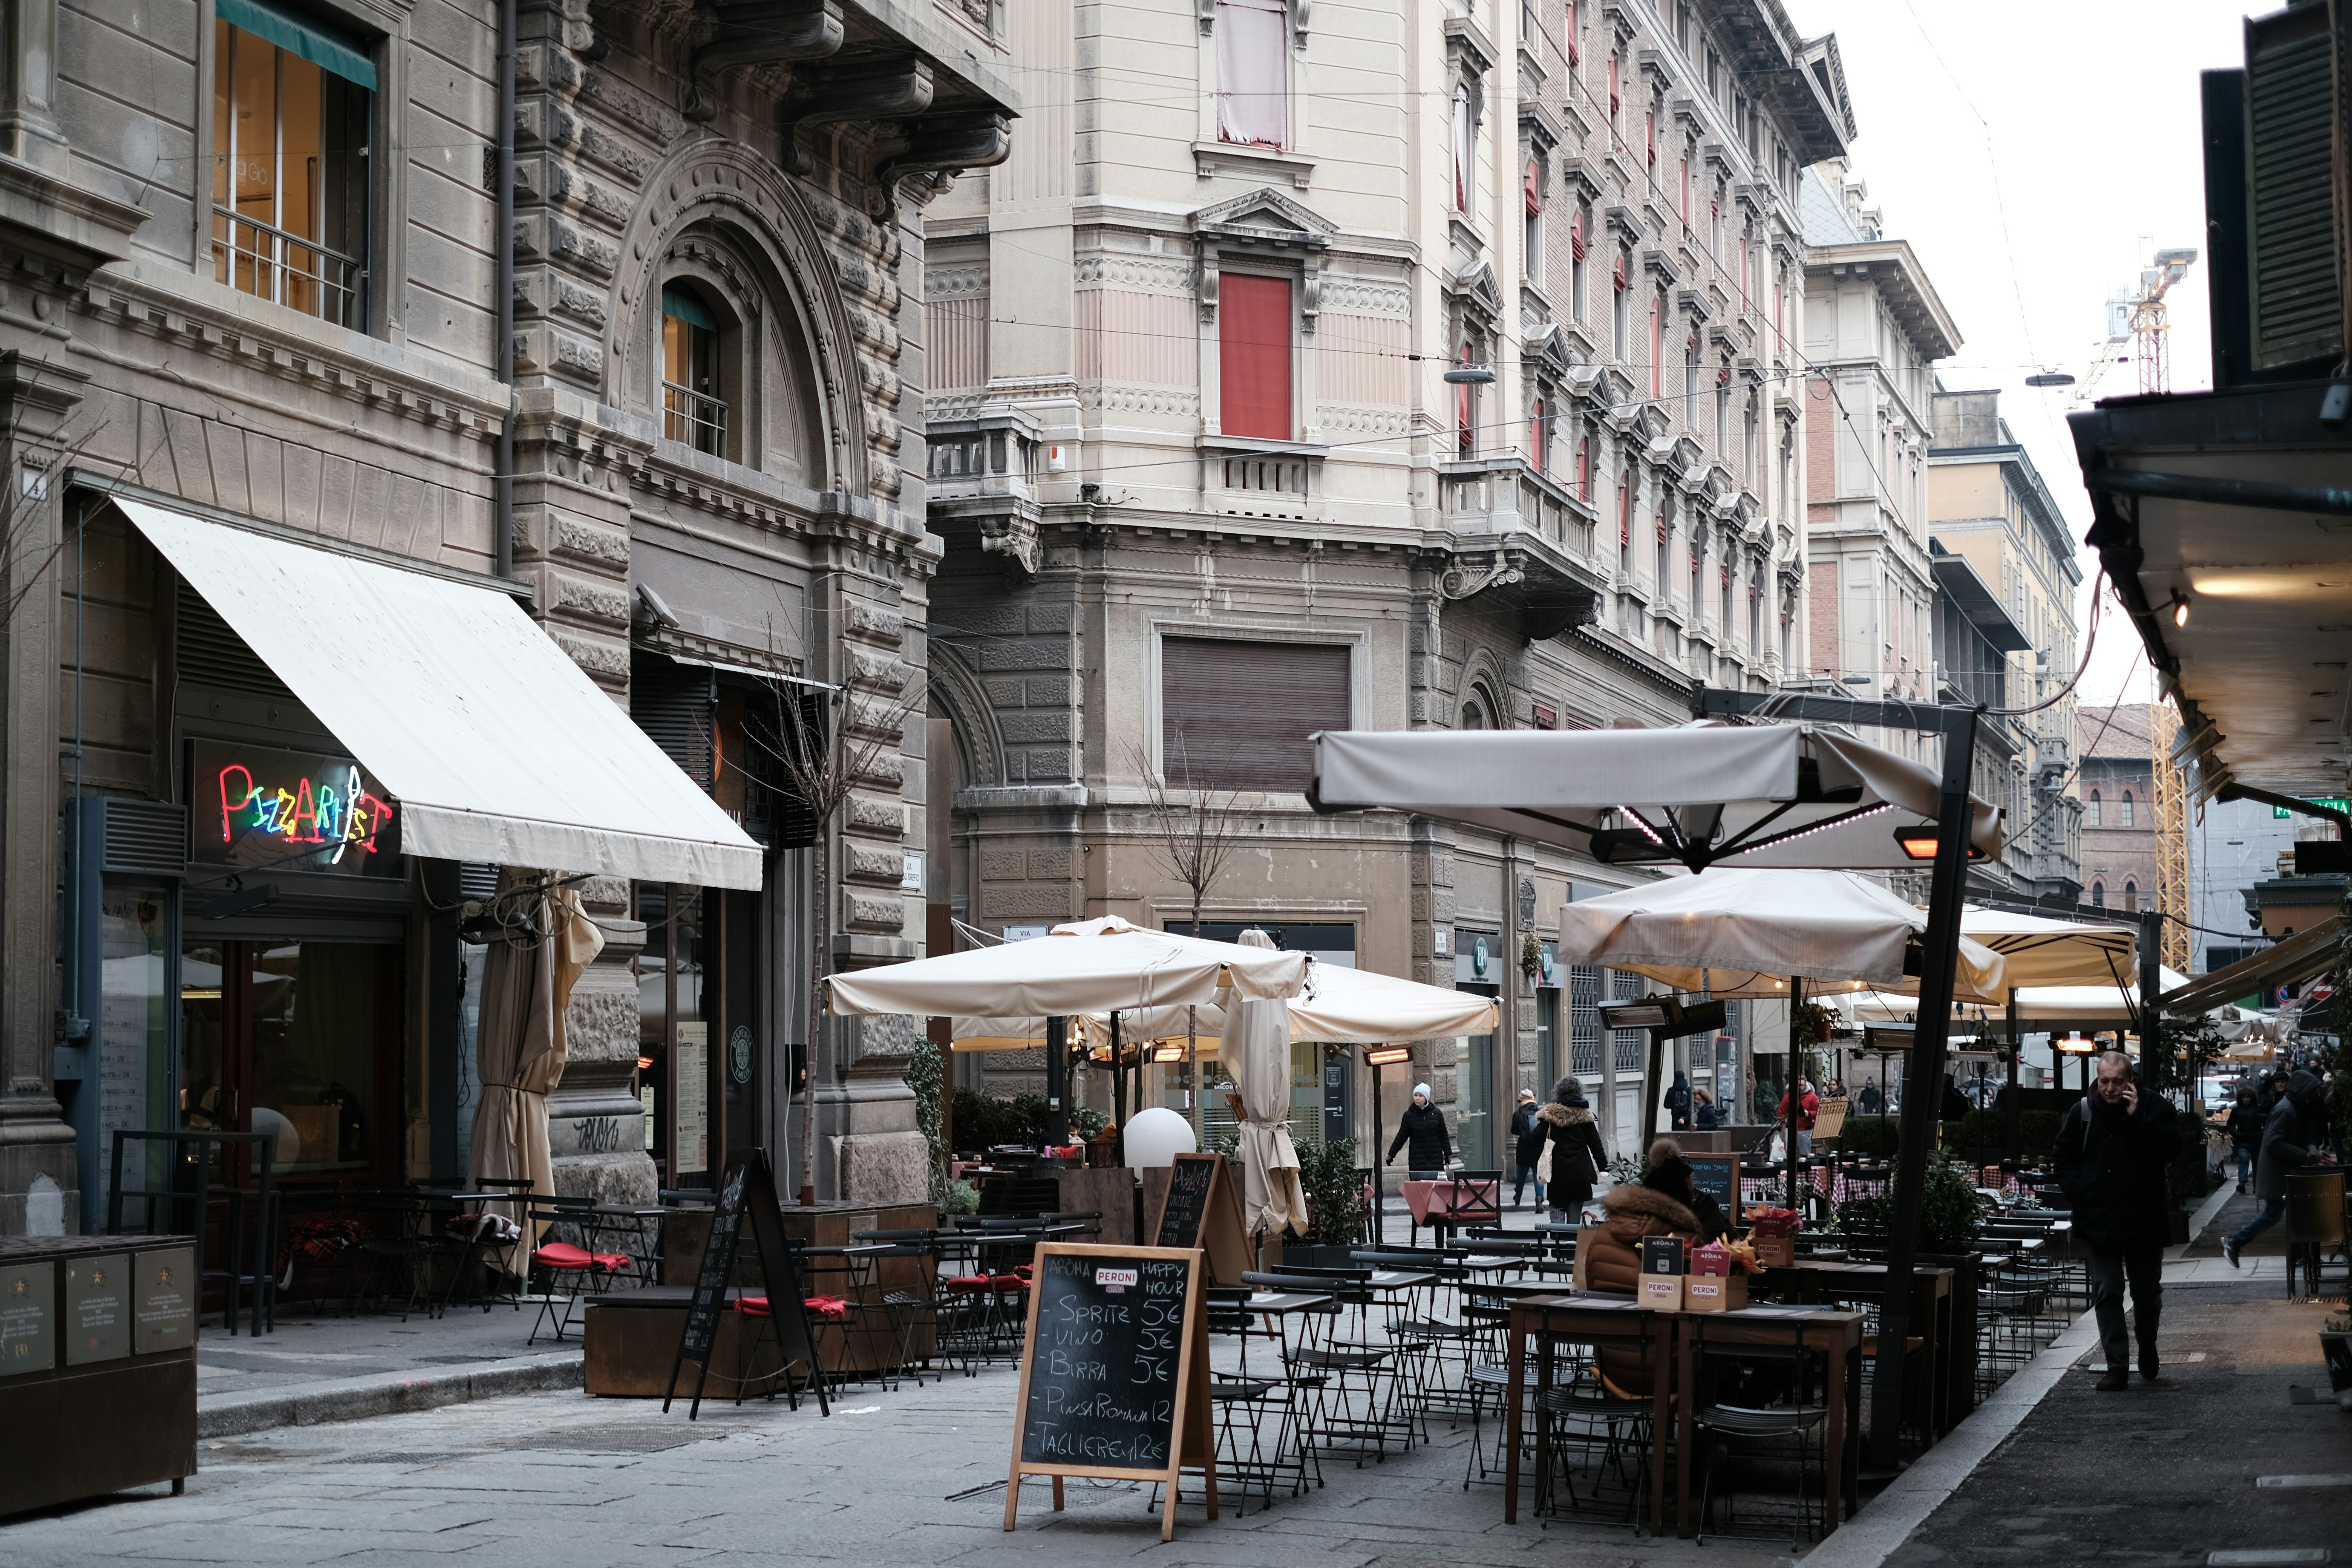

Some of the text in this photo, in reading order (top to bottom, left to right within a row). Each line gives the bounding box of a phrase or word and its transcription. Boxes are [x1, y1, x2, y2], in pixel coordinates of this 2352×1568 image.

[732, 1029, 752, 1049] DISPENSA
[735, 1067, 751, 1080] EMILIA
[288, 1124, 323, 1140] OVS
[1169, 1195, 1193, 1208] TAGLIERE
[1098, 1271, 1135, 1282] PERONI
[1142, 1262, 1184, 1277] HAPPY
[1146, 1280, 1184, 1297] HOUR
[1141, 1299, 1181, 1326] 5€
[1056, 1328, 1175, 1350] VINO 5€
[1050, 1349, 1168, 1384] BIRRA 5€
[1153, 1400, 1170, 1423] 12
